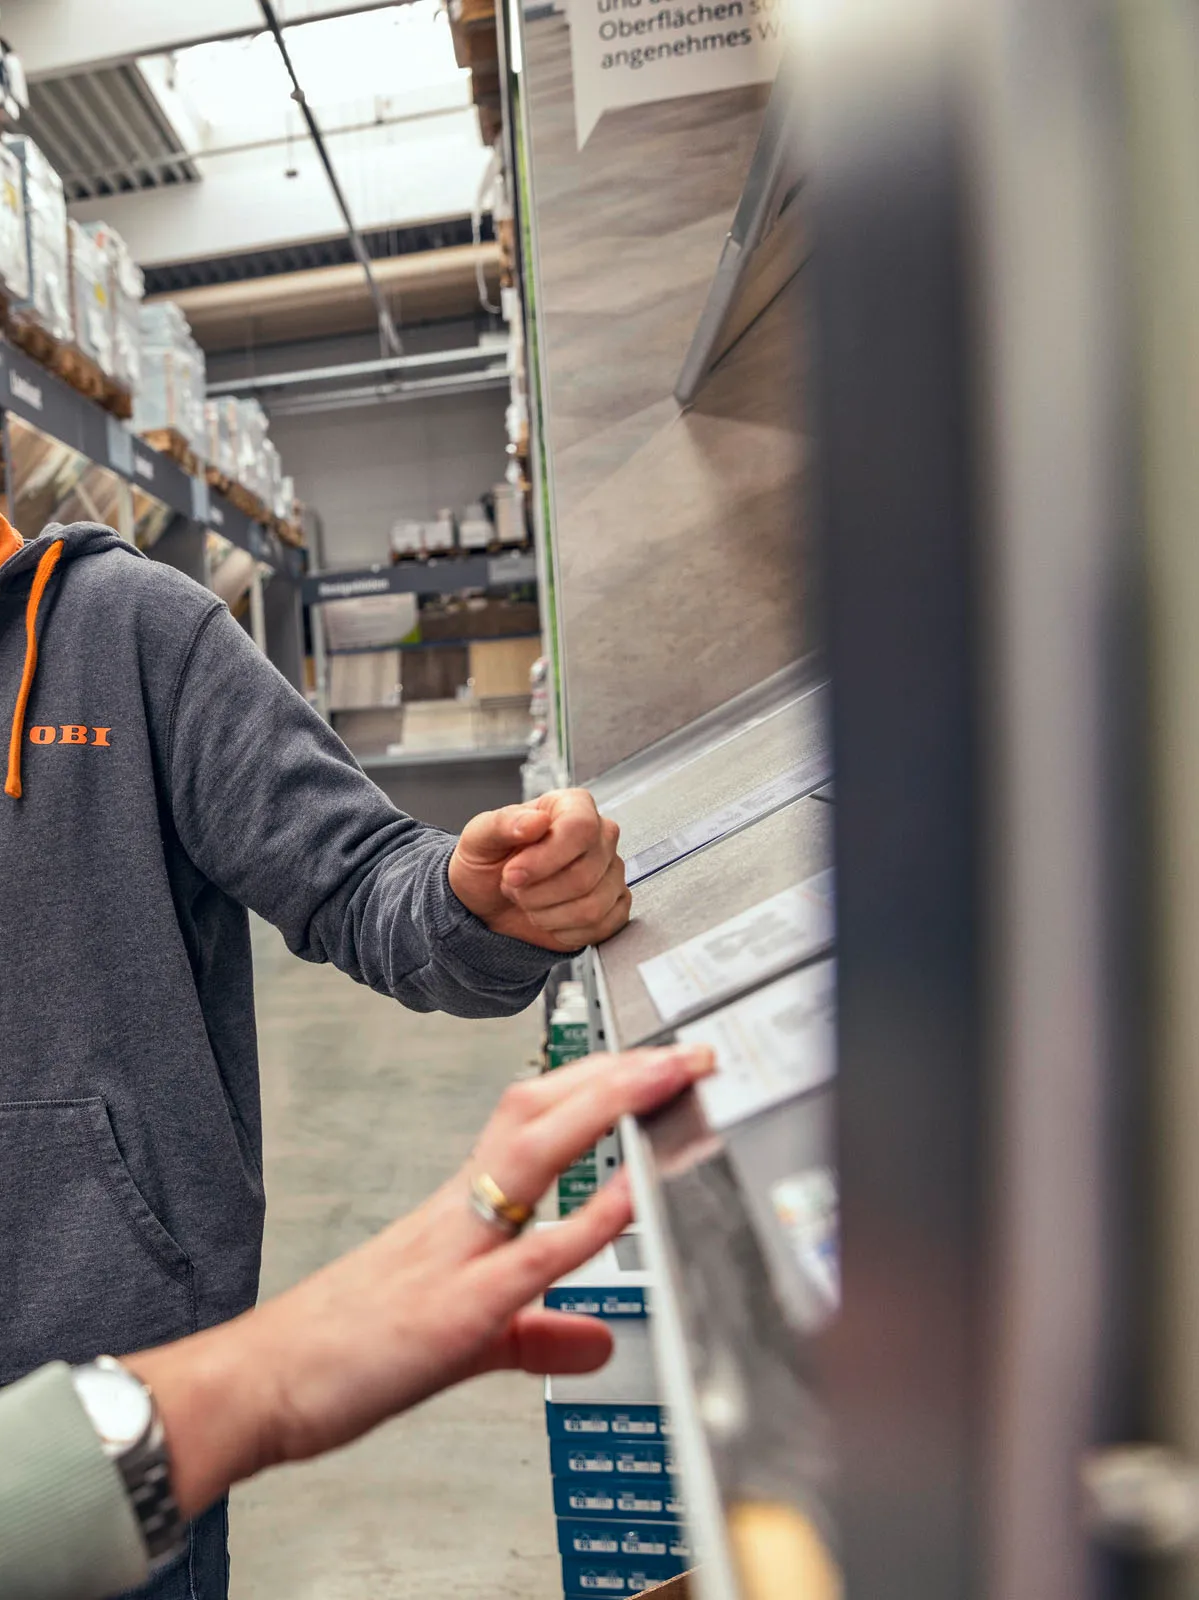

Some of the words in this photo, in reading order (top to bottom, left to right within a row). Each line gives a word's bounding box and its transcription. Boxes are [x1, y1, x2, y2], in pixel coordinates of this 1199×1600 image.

[599, 2, 743, 42] Oberflächen
[601, 29, 752, 70] angenehmes
[29, 725, 112, 747] OBI
